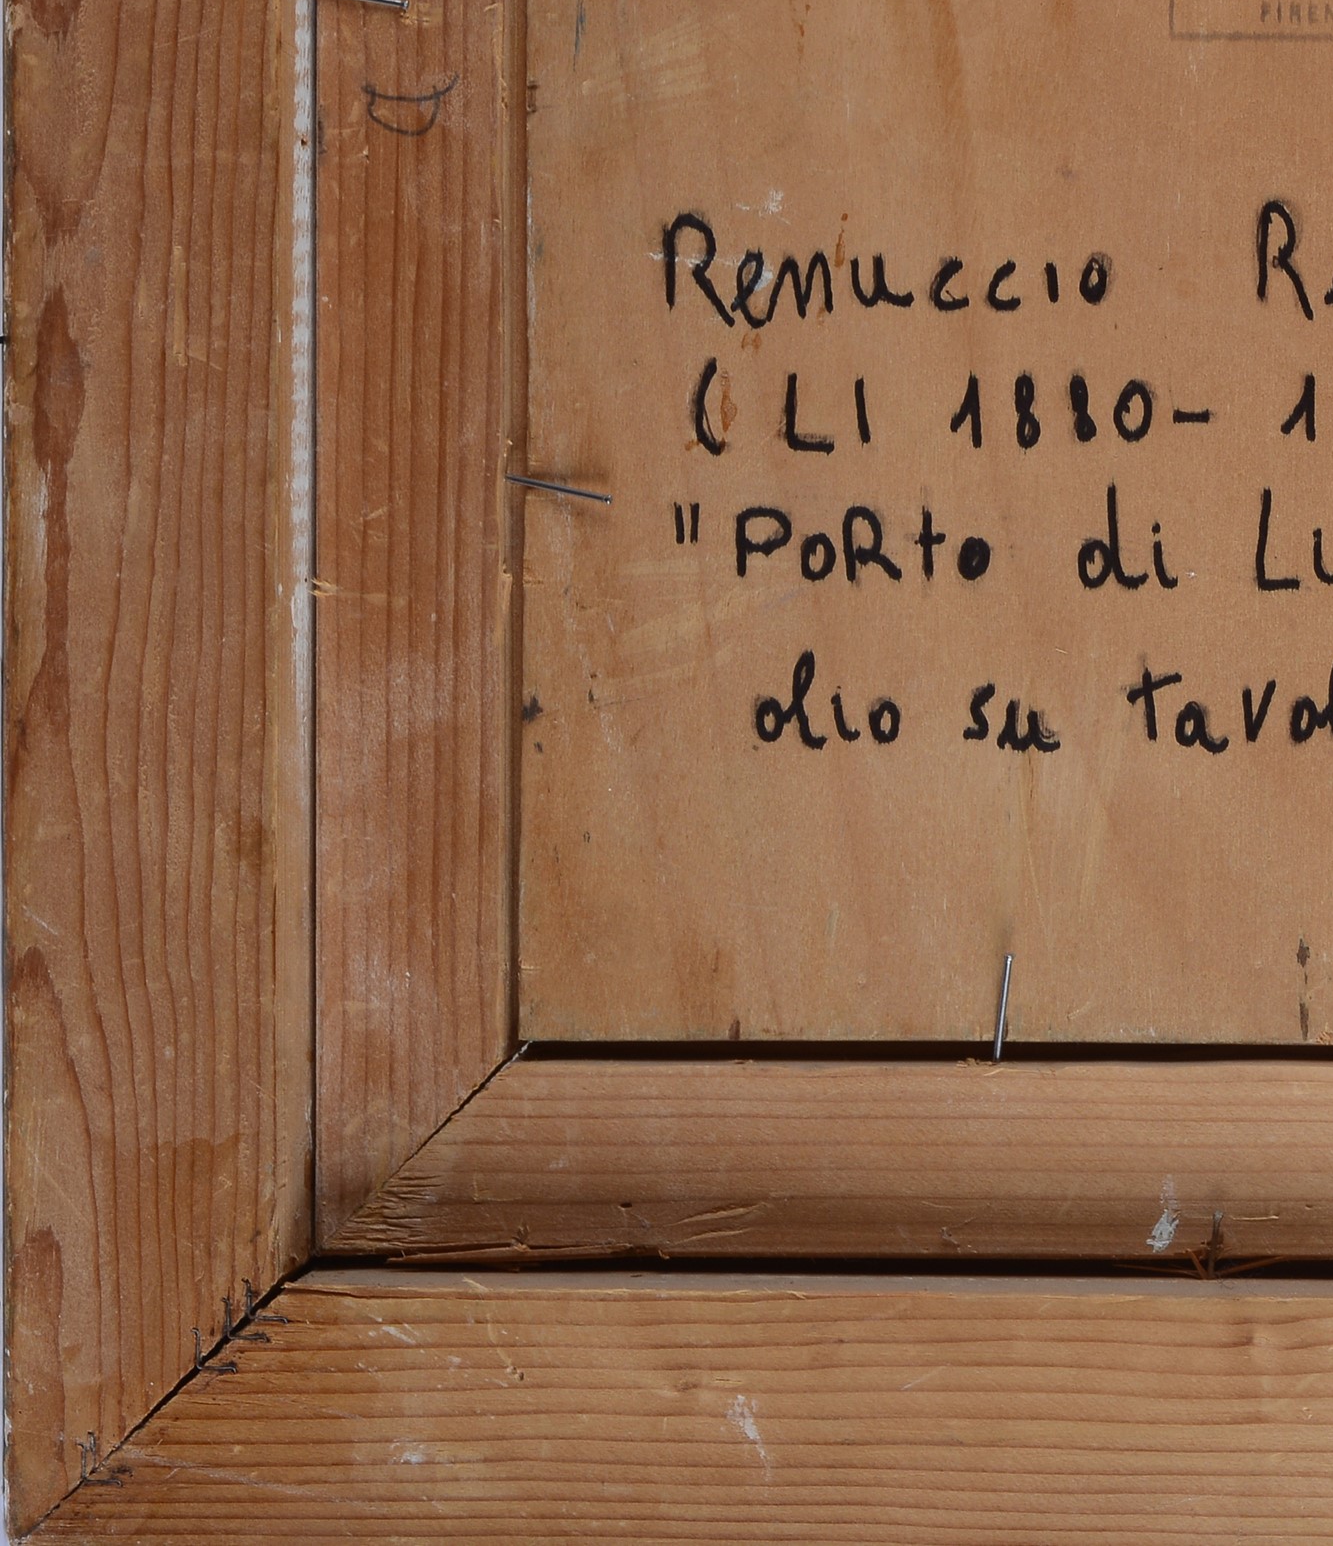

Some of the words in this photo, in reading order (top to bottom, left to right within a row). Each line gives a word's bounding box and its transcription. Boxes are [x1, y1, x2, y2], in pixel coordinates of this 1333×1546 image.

[1078, 481, 1177, 589] di
[754, 649, 901, 751] olio
[962, 681, 1061, 752] su
